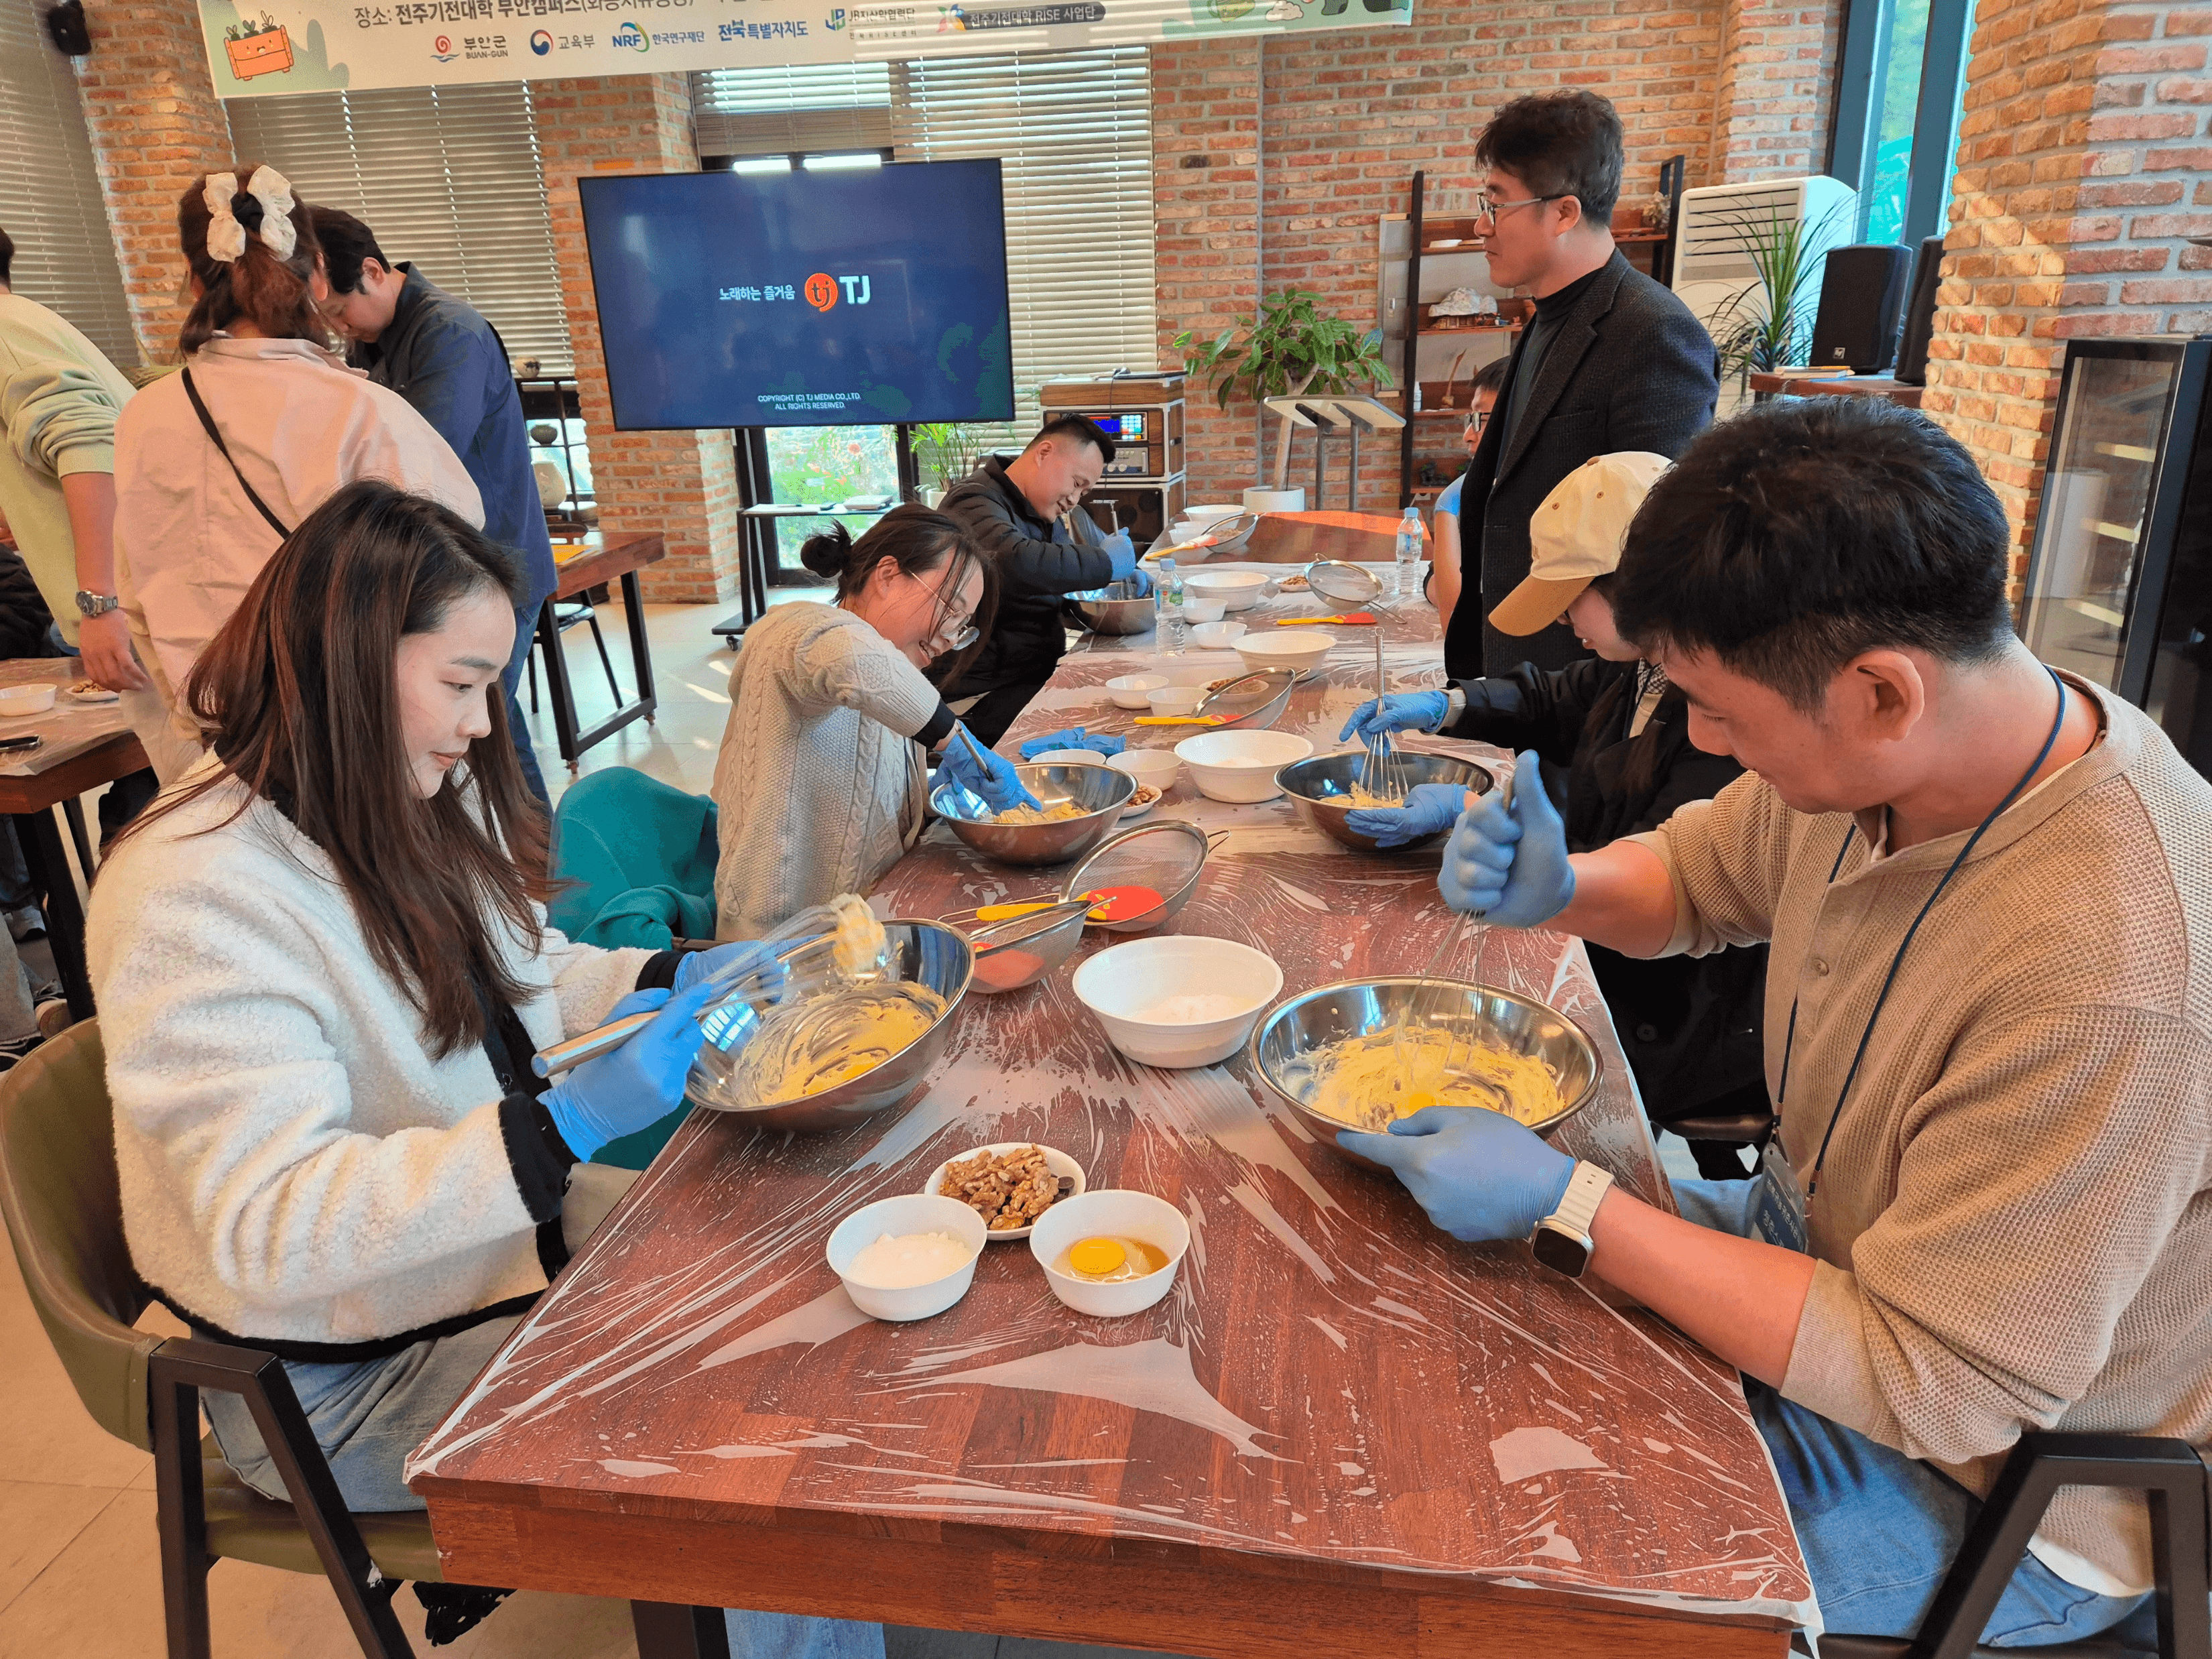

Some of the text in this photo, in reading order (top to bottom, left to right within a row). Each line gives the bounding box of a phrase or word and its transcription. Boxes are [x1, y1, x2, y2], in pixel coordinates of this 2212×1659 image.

[354, 6, 392, 28] 장소:
[395, 0, 493, 25] 전주기전대학
[970, 5, 1096, 27] 전주기전대학 RISE 사업단
[652, 30, 704, 45] 한국연구재단
[718, 19, 808, 42] 전북특별자치도
[464, 35, 507, 51] 부안군
[558, 34, 595, 50] 교육부
[611, 34, 641, 47] NRF
[466, 50, 509, 60] BUAN-GUN
[719, 286, 761, 301] 노래하는
[763, 284, 796, 301] 즐거움
[839, 275, 871, 304] TJ
[757, 394, 794, 402] COPYRIGHT
[796, 393, 805, 402] (C)
[814, 393, 835, 401] MEDIA
[812, 402, 846, 410] RESERVED.
